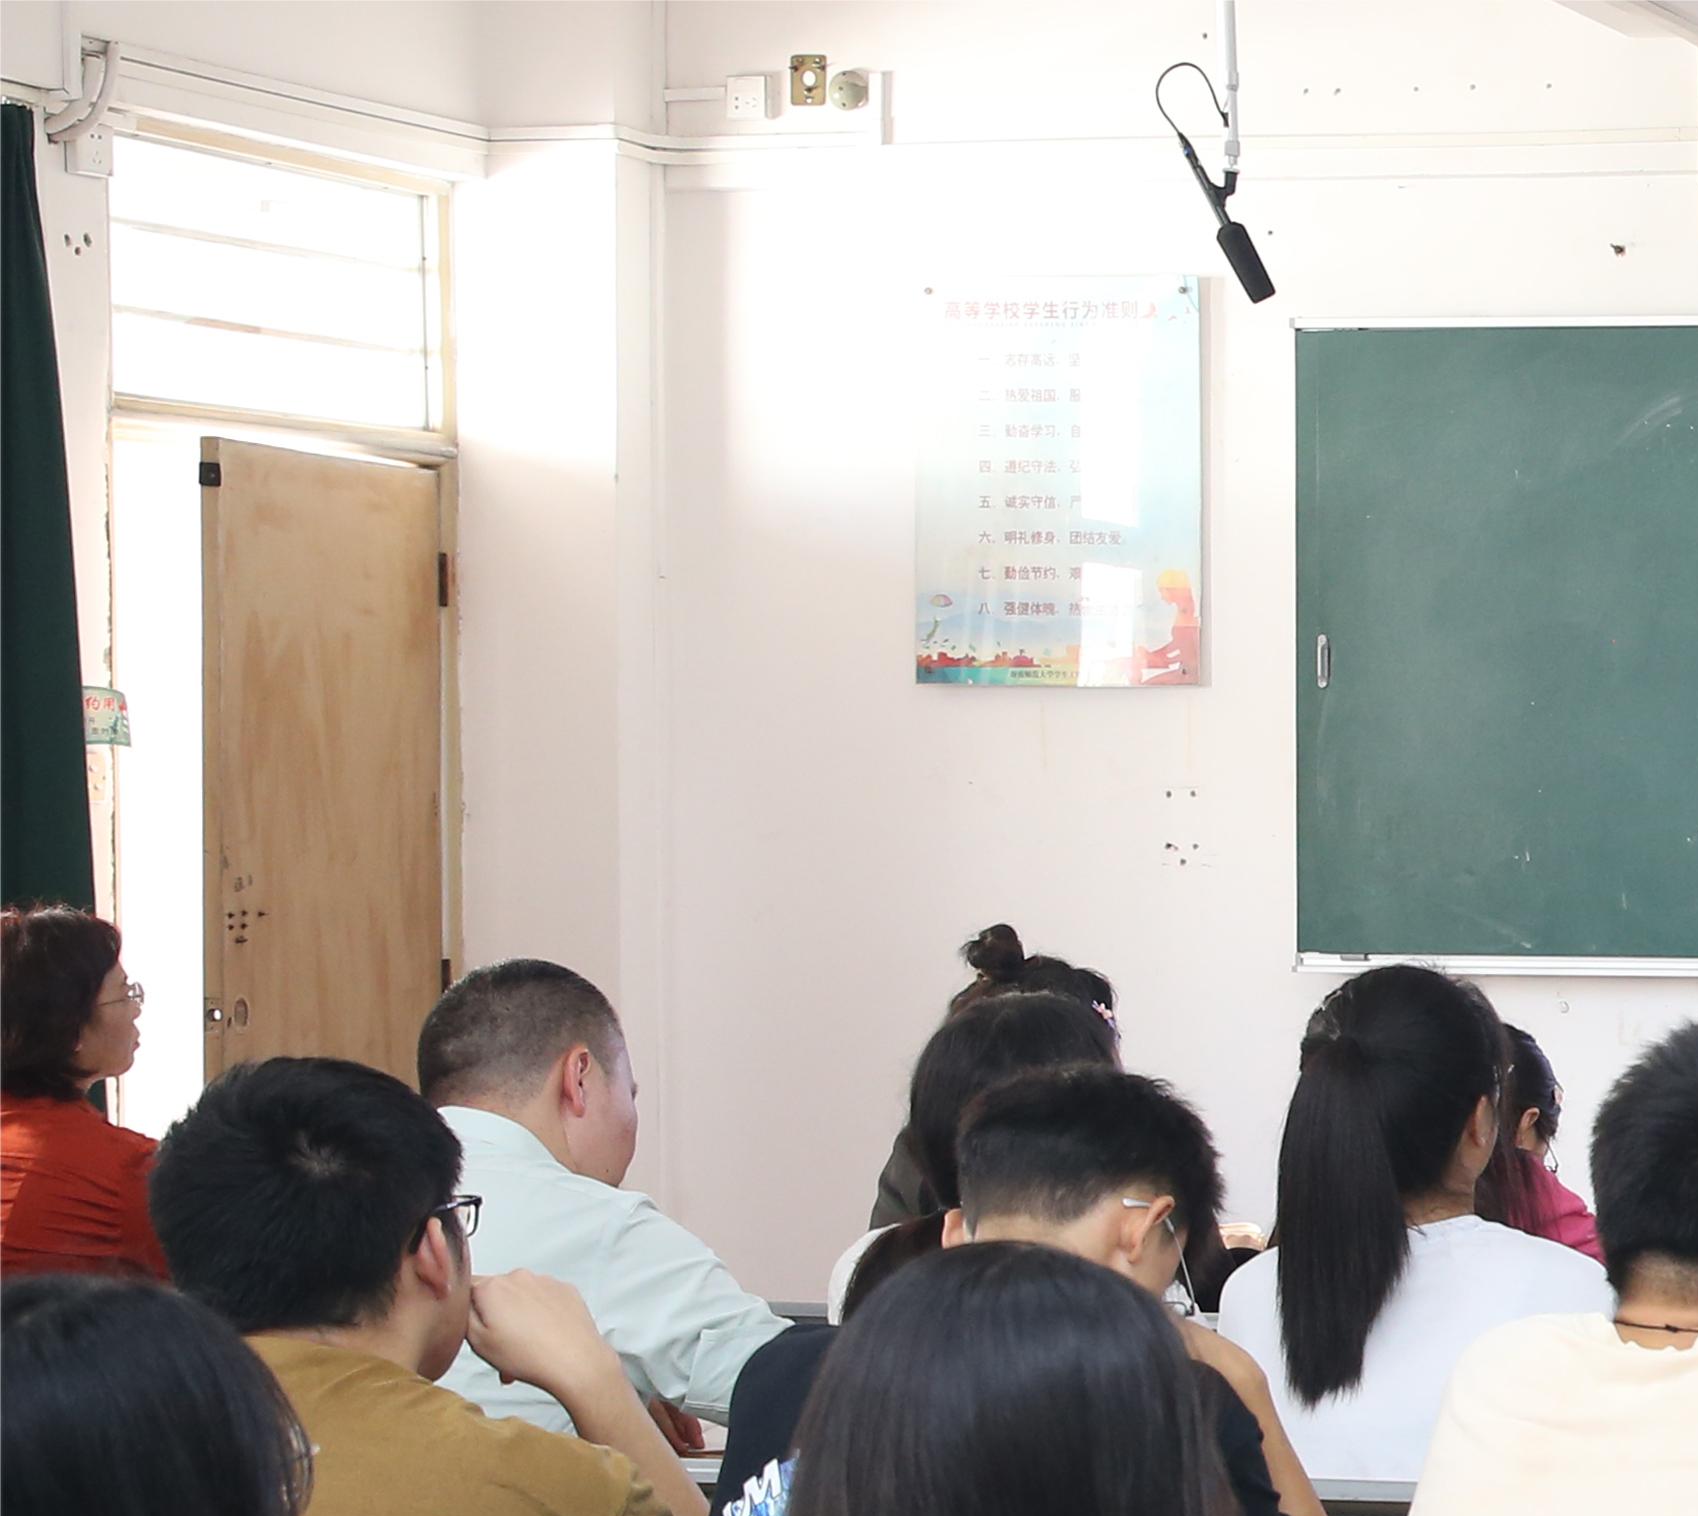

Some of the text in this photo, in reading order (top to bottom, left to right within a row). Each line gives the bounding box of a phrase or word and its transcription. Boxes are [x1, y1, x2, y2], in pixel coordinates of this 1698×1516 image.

[944, 301, 1139, 320] 高等学校学生行为准则
